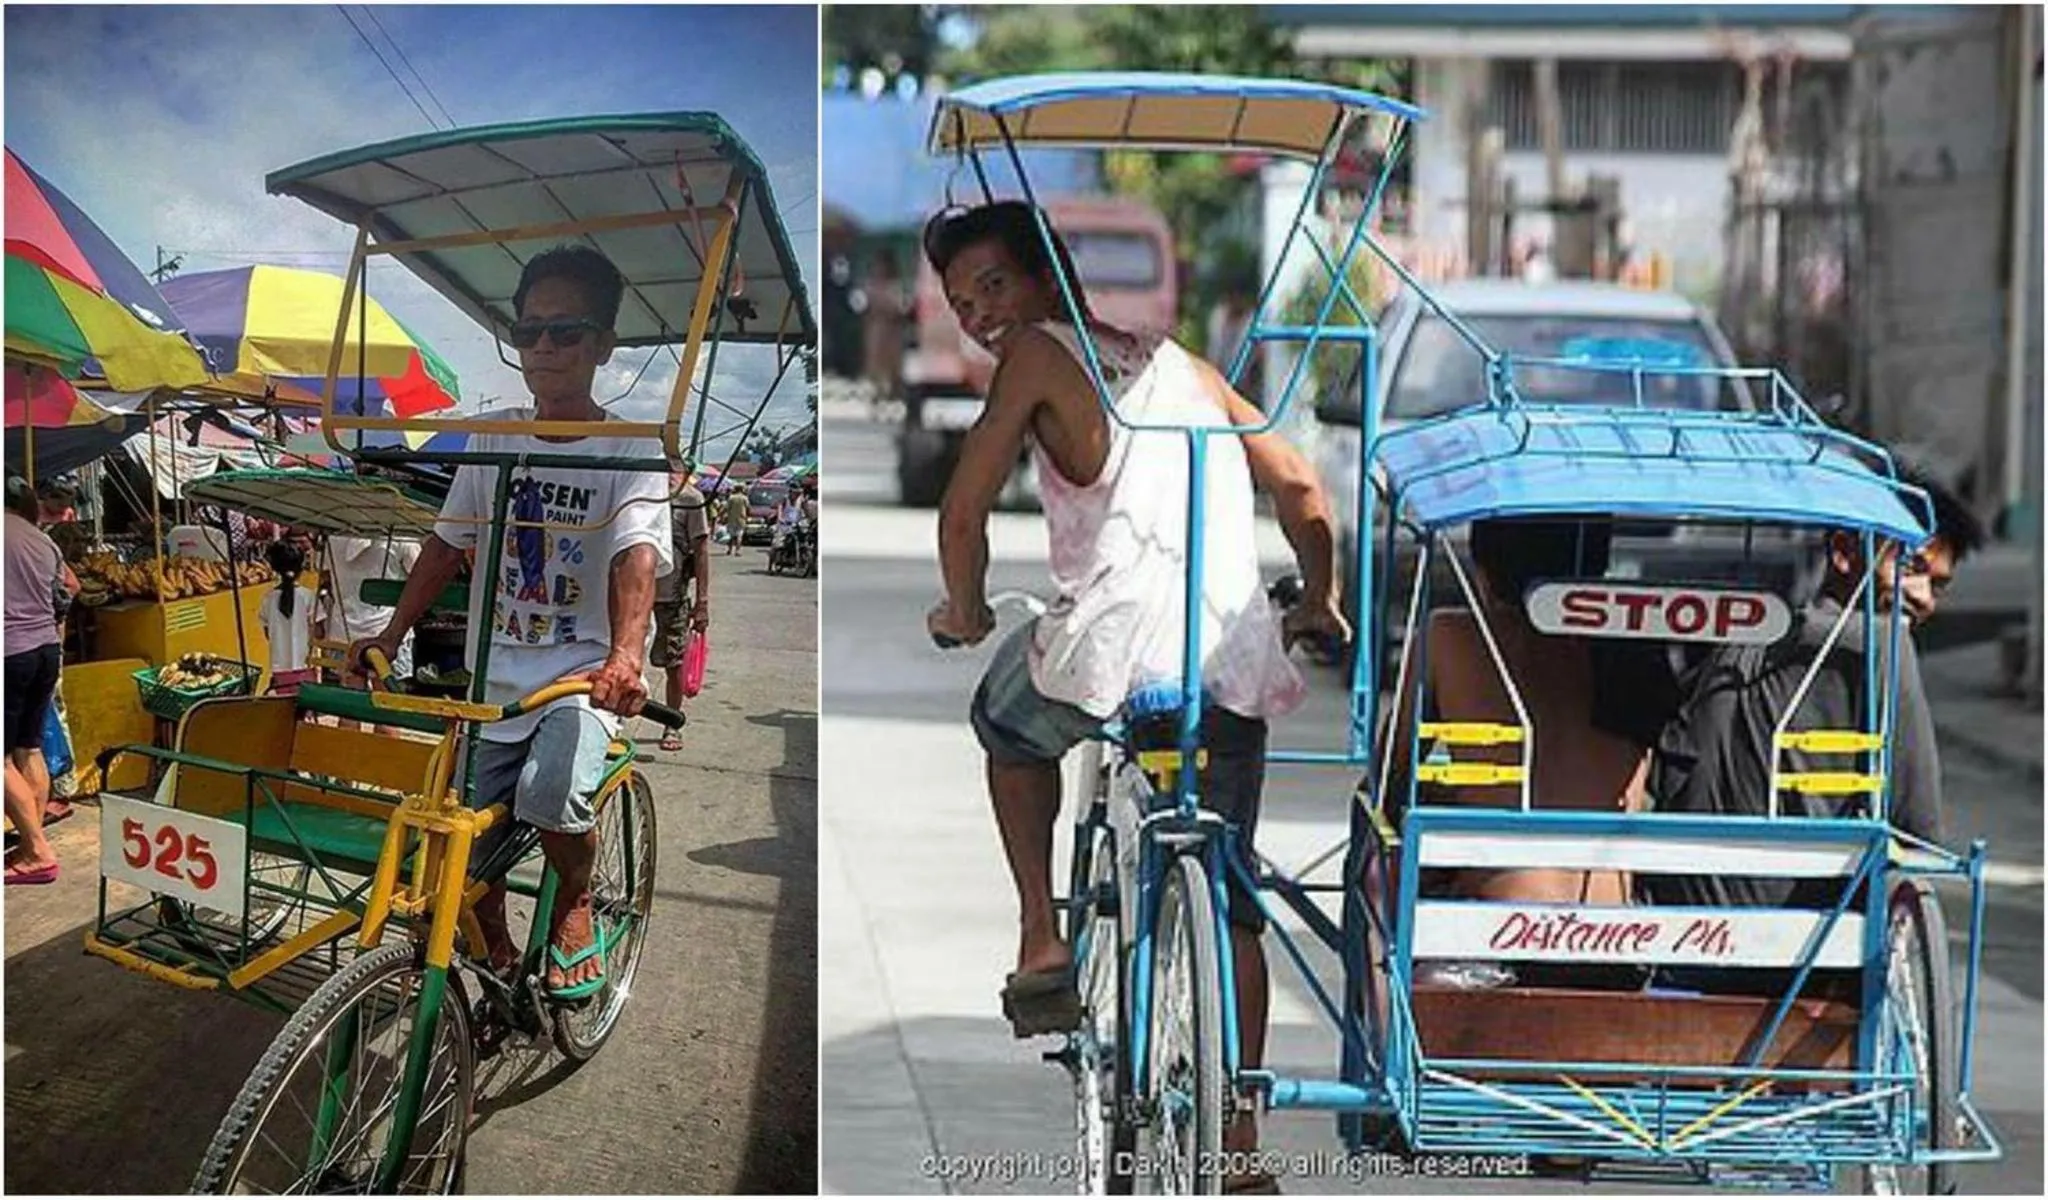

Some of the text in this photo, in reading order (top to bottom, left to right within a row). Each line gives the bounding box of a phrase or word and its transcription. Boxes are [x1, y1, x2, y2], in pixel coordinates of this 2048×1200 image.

[546, 509, 586, 527] PAINT
[1561, 590, 1767, 637] STOP
[122, 816, 218, 890] 525
[1489, 911, 1661, 952] Distance
